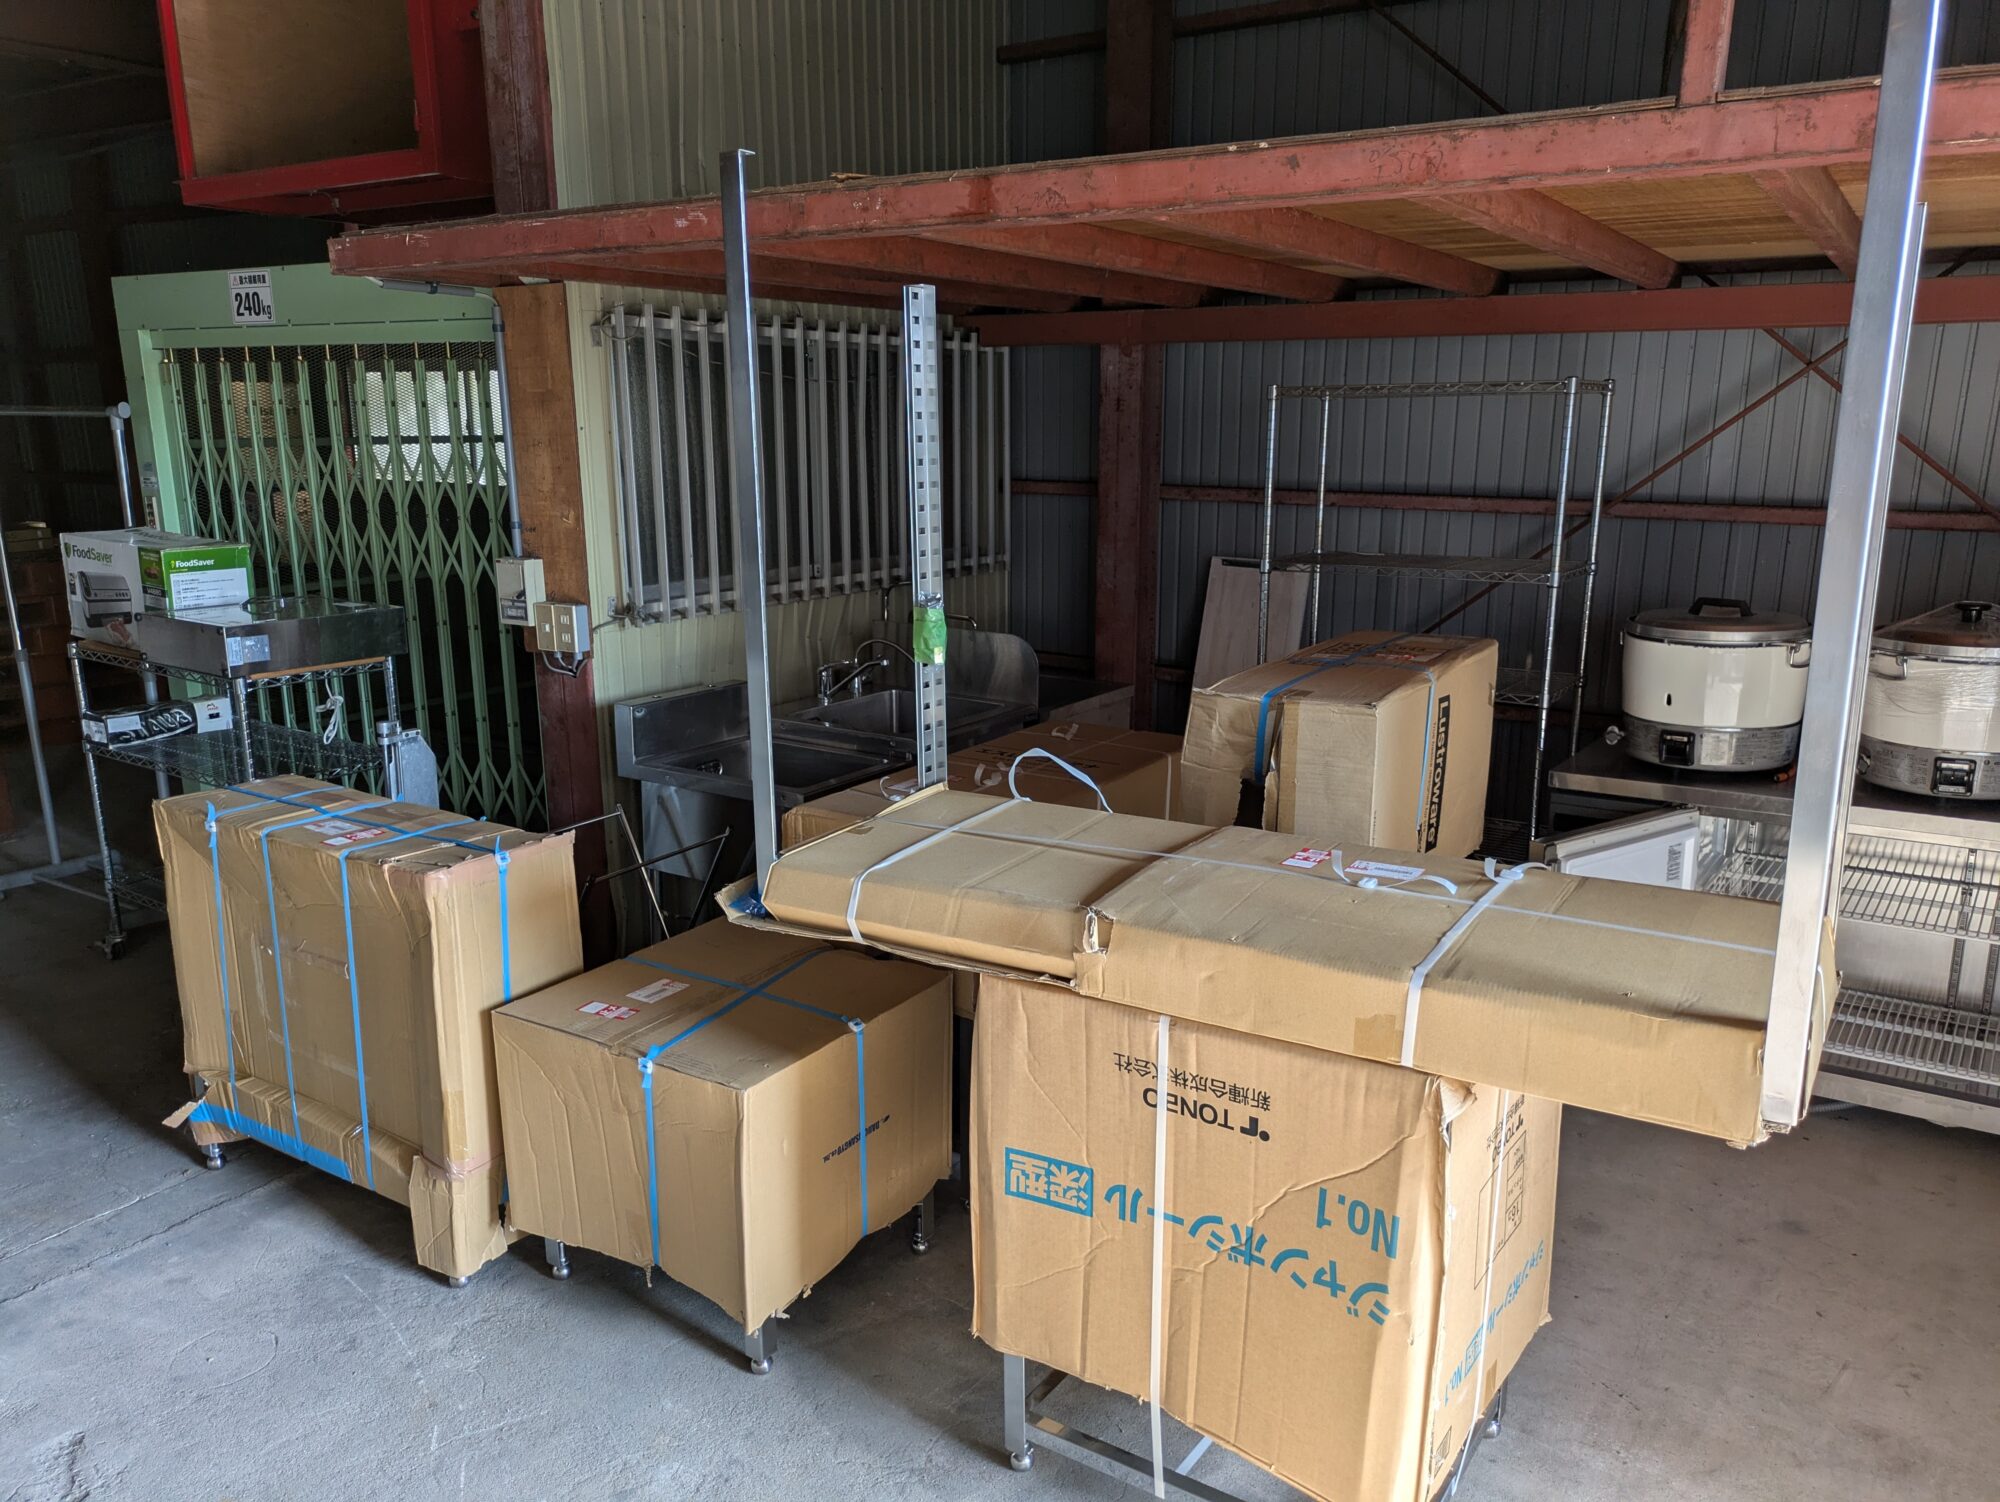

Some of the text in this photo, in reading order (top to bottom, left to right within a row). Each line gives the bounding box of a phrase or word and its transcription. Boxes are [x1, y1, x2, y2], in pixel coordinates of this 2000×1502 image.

[72, 545, 113, 564] FoodSaver
[175, 558, 215, 568] FoodSaver
[1427, 702, 1449, 843] Lustroware
[1008, 1153, 1391, 1327] ジャンボシール 深型
[1314, 1186, 1401, 1259] No.1
